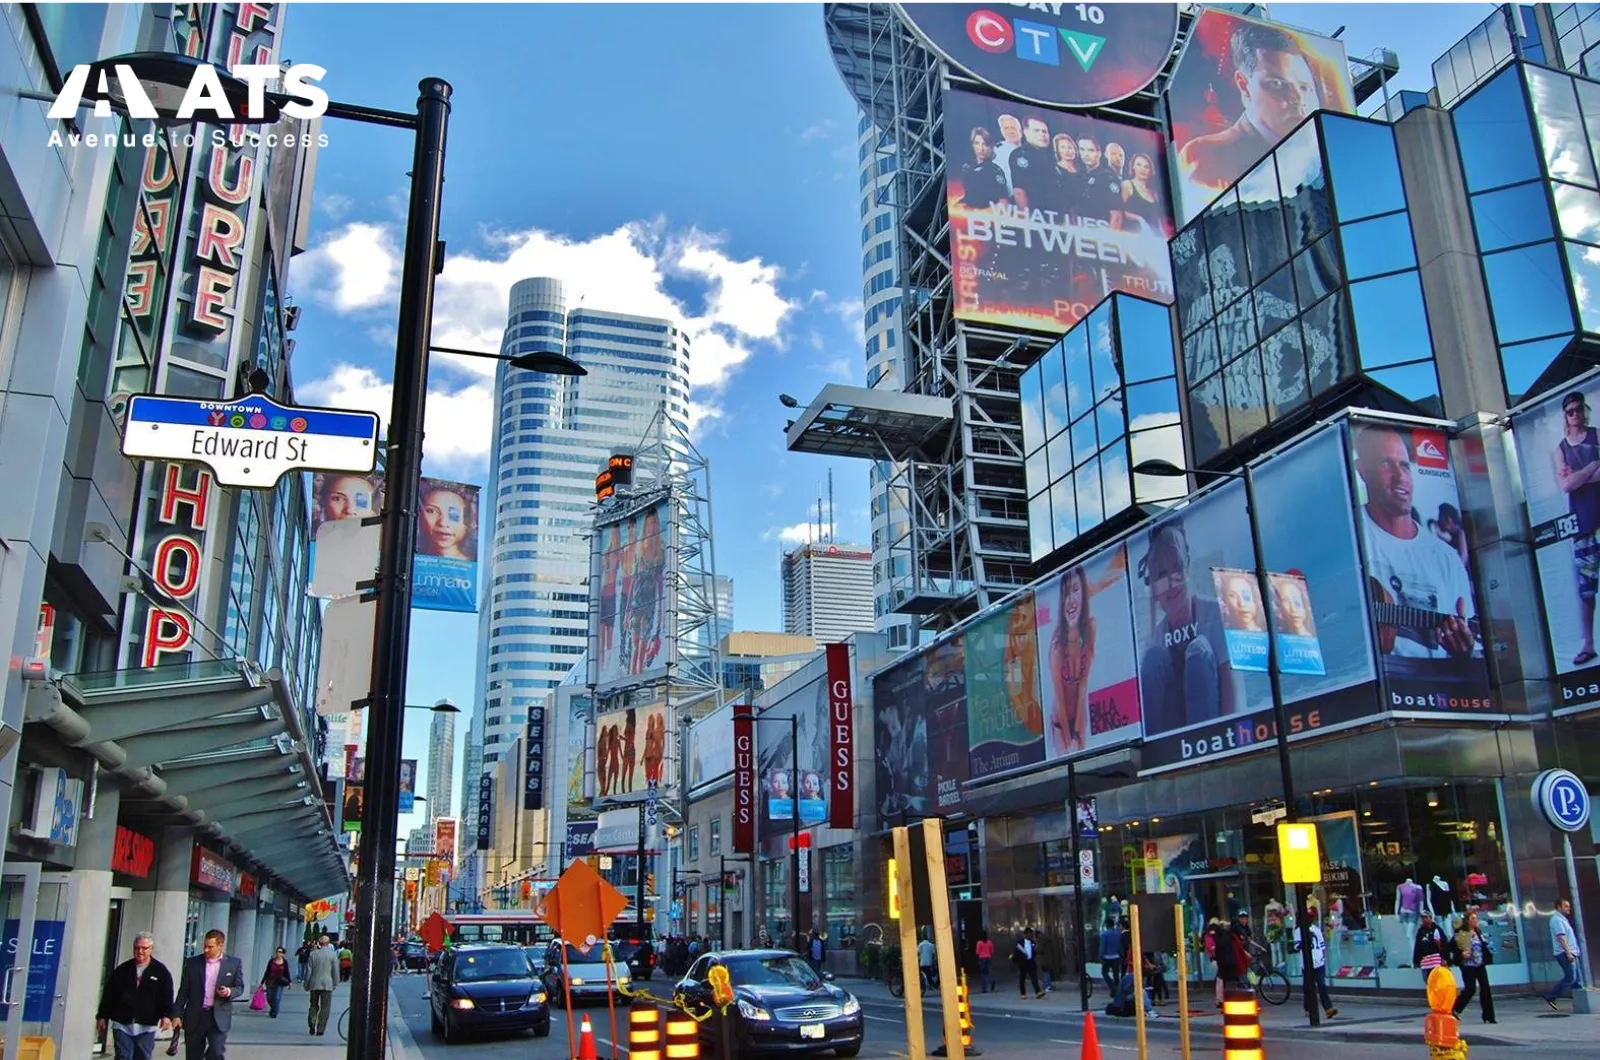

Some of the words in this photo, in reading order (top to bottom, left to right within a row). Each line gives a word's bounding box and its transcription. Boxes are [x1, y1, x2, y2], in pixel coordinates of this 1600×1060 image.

[1075, 3, 1105, 25] 10
[973, 15, 1100, 64] CTV
[988, 201, 1058, 228] WHAT
[1064, 213, 1110, 231] LIES
[959, 265, 1009, 281] BETRAYAL
[200, 402, 263, 414] DOWNTOWN
[191, 429, 279, 460] Edward
[285, 435, 309, 463] St
[143, 463, 212, 668] HOP
[1163, 621, 1199, 648] ROXY
[1391, 691, 1492, 709] boathouse
[1562, 684, 1599, 700] boa
[528, 708, 542, 790] SEARS
[832, 680, 851, 791] GUESS
[736, 735, 750, 824] GUESS
[479, 777, 491, 836] SEARS
[1556, 785, 1576, 816] P
[1190, 859, 1209, 870] boat
[1323, 871, 1349, 882] BIKINI
[7, 937, 56, 955] SLE
